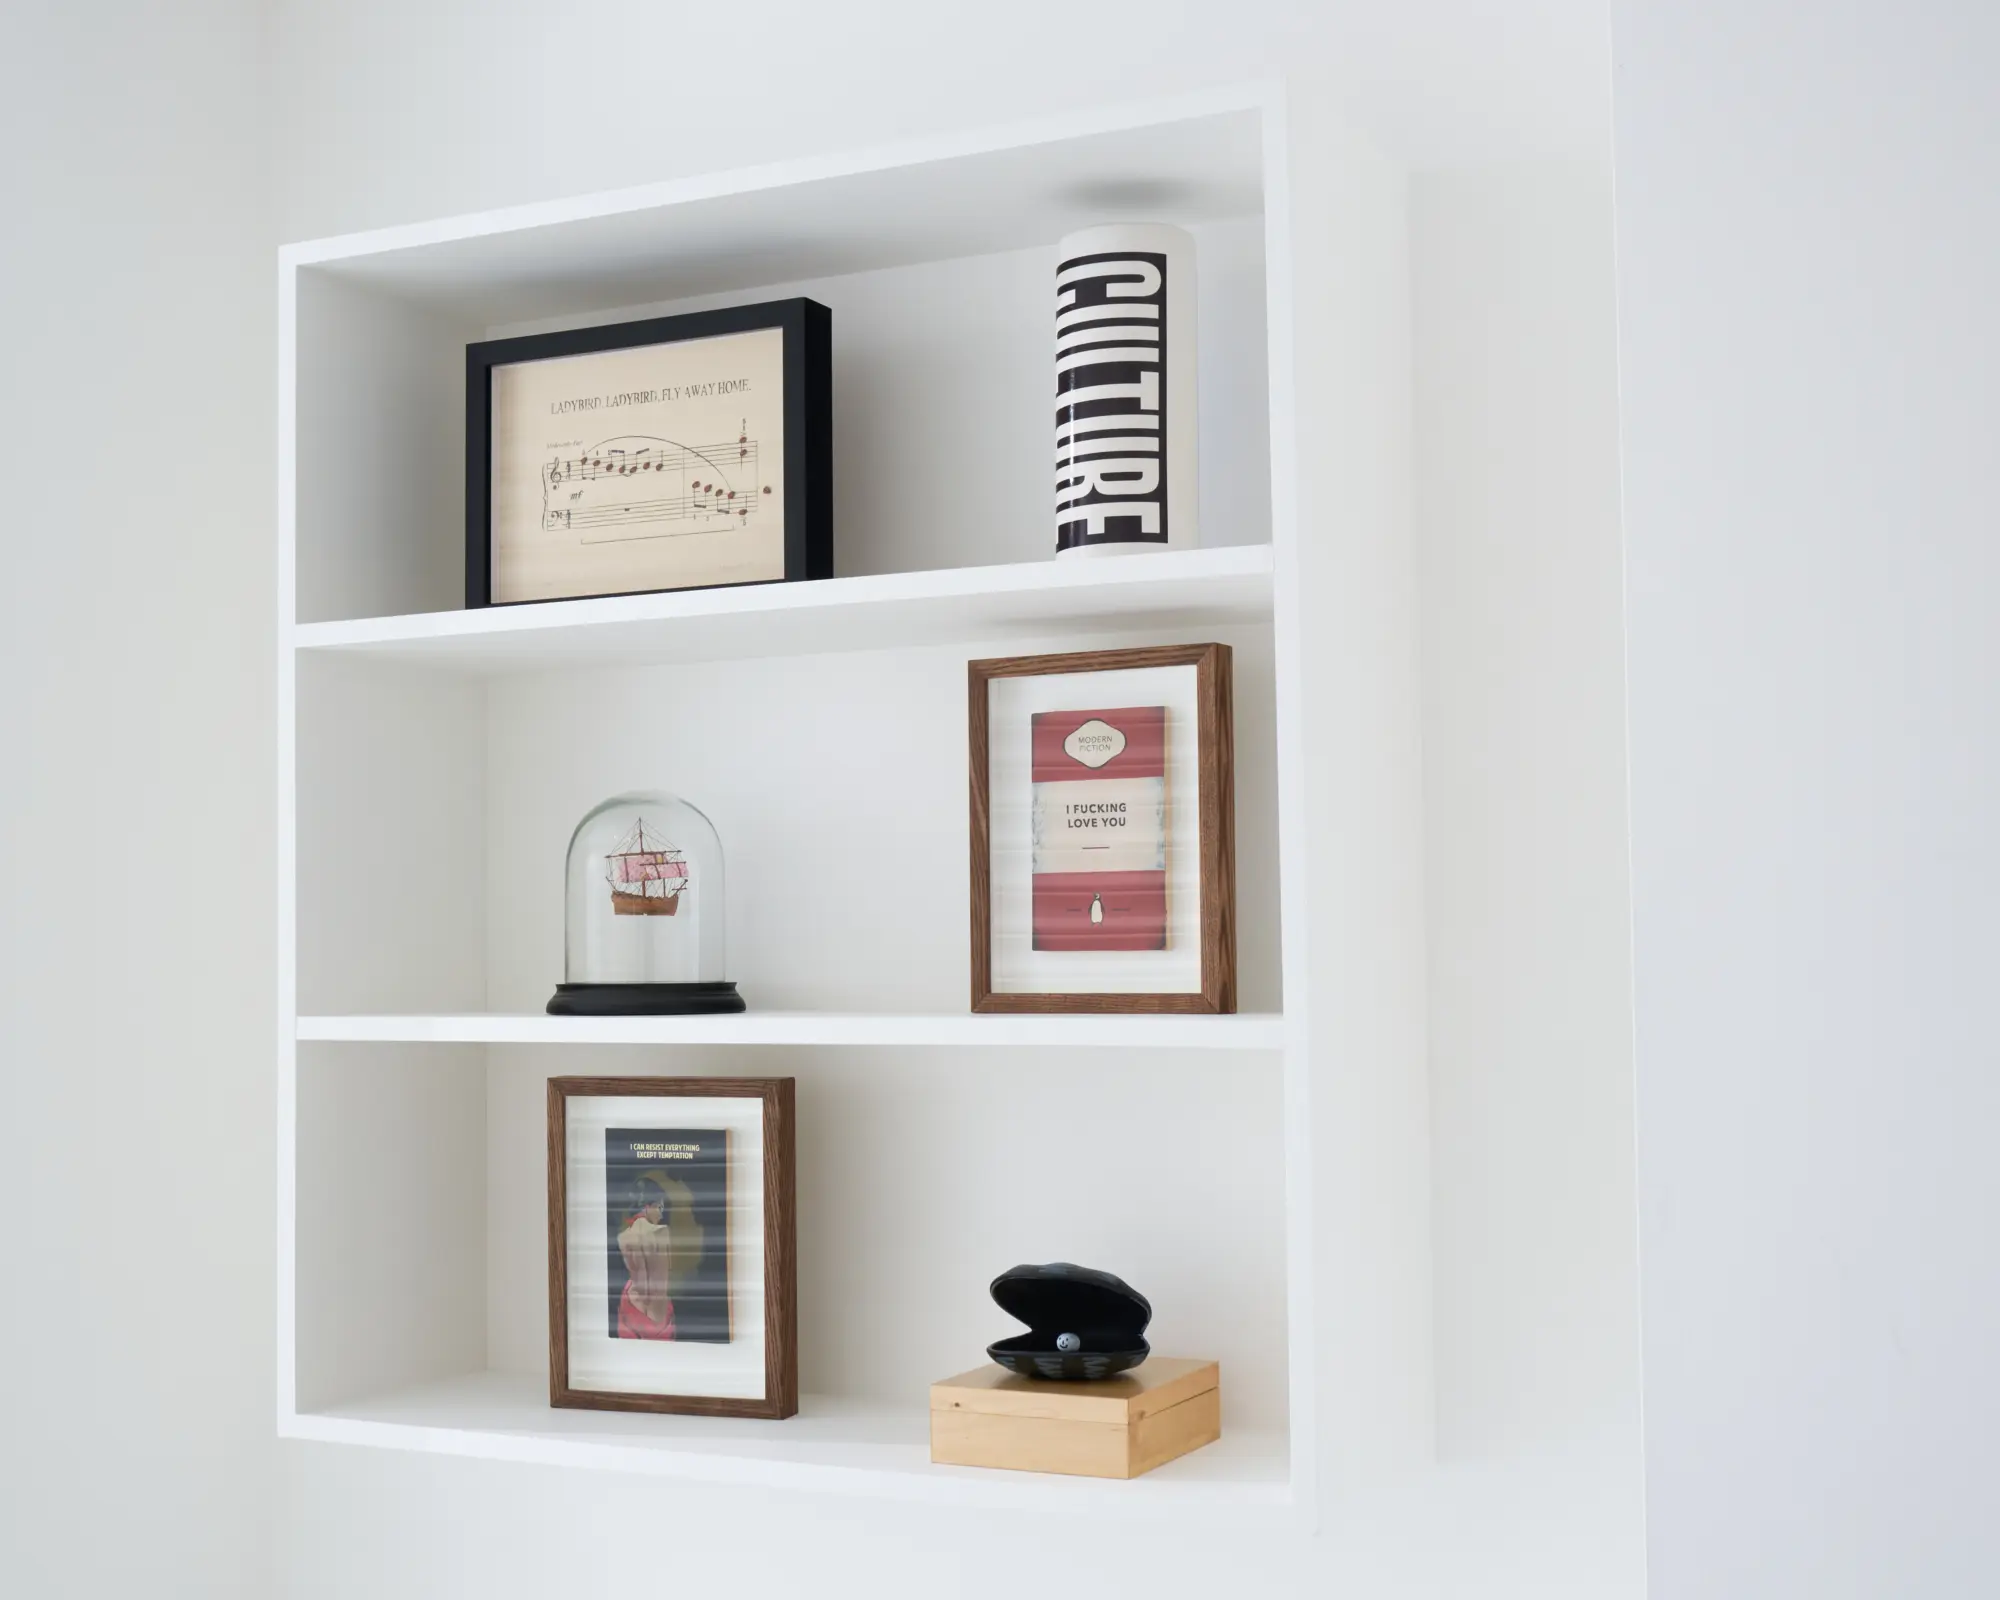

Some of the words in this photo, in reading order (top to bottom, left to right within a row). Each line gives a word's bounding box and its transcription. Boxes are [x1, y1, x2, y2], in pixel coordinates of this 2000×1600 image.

[606, 390, 660, 408] LADYBIRD,
[662, 387, 681, 401] FLY
[684, 383, 716, 398] AWAY
[718, 379, 752, 395] HOME.
[1056, 260, 1162, 545] CULTURE
[1078, 735, 1113, 744] MODERN
[1079, 744, 1111, 752] FICTION
[1066, 804, 1070, 814] I
[1073, 802, 1127, 814] FUCKING
[1067, 818, 1098, 828] LOVE
[1101, 816, 1126, 827] YOU
[633, 1143, 645, 1151] CAN
[645, 1143, 664, 1151] RESIST
[665, 1143, 700, 1152] EVERYTHING
[658, 1151, 693, 1160] TEMPTATION
